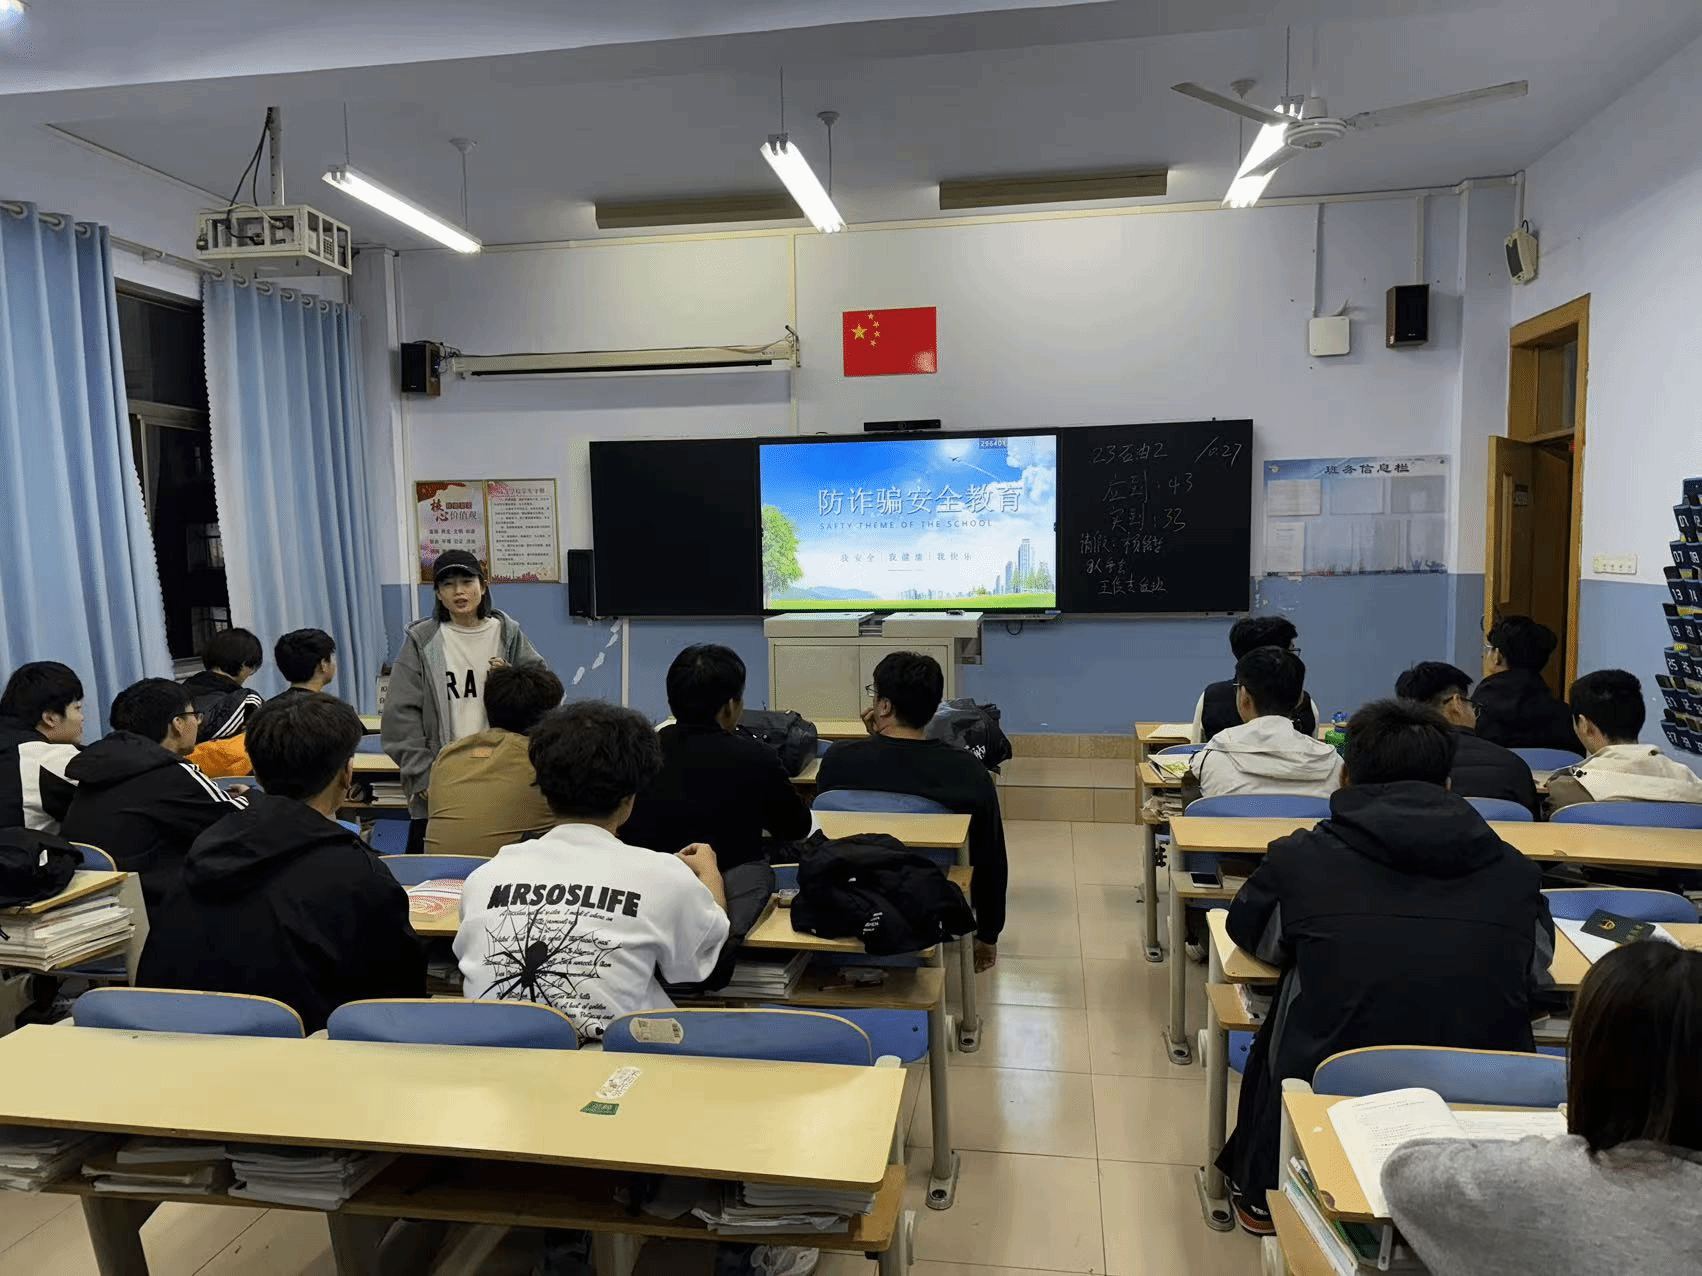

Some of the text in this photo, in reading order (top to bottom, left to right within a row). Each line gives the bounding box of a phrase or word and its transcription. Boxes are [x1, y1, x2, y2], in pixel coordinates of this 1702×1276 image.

[1324, 463, 1410, 475] 班务信息栏
[818, 484, 1023, 516] 防诈骗安全教育
[858, 522, 894, 530] THEME
[901, 521, 914, 529] OF
[921, 520, 941, 528] THE
[947, 519, 992, 528] SCHOOL
[1672, 589, 1683, 600] 13
[487, 883, 642, 918] MRSOSLIFE
